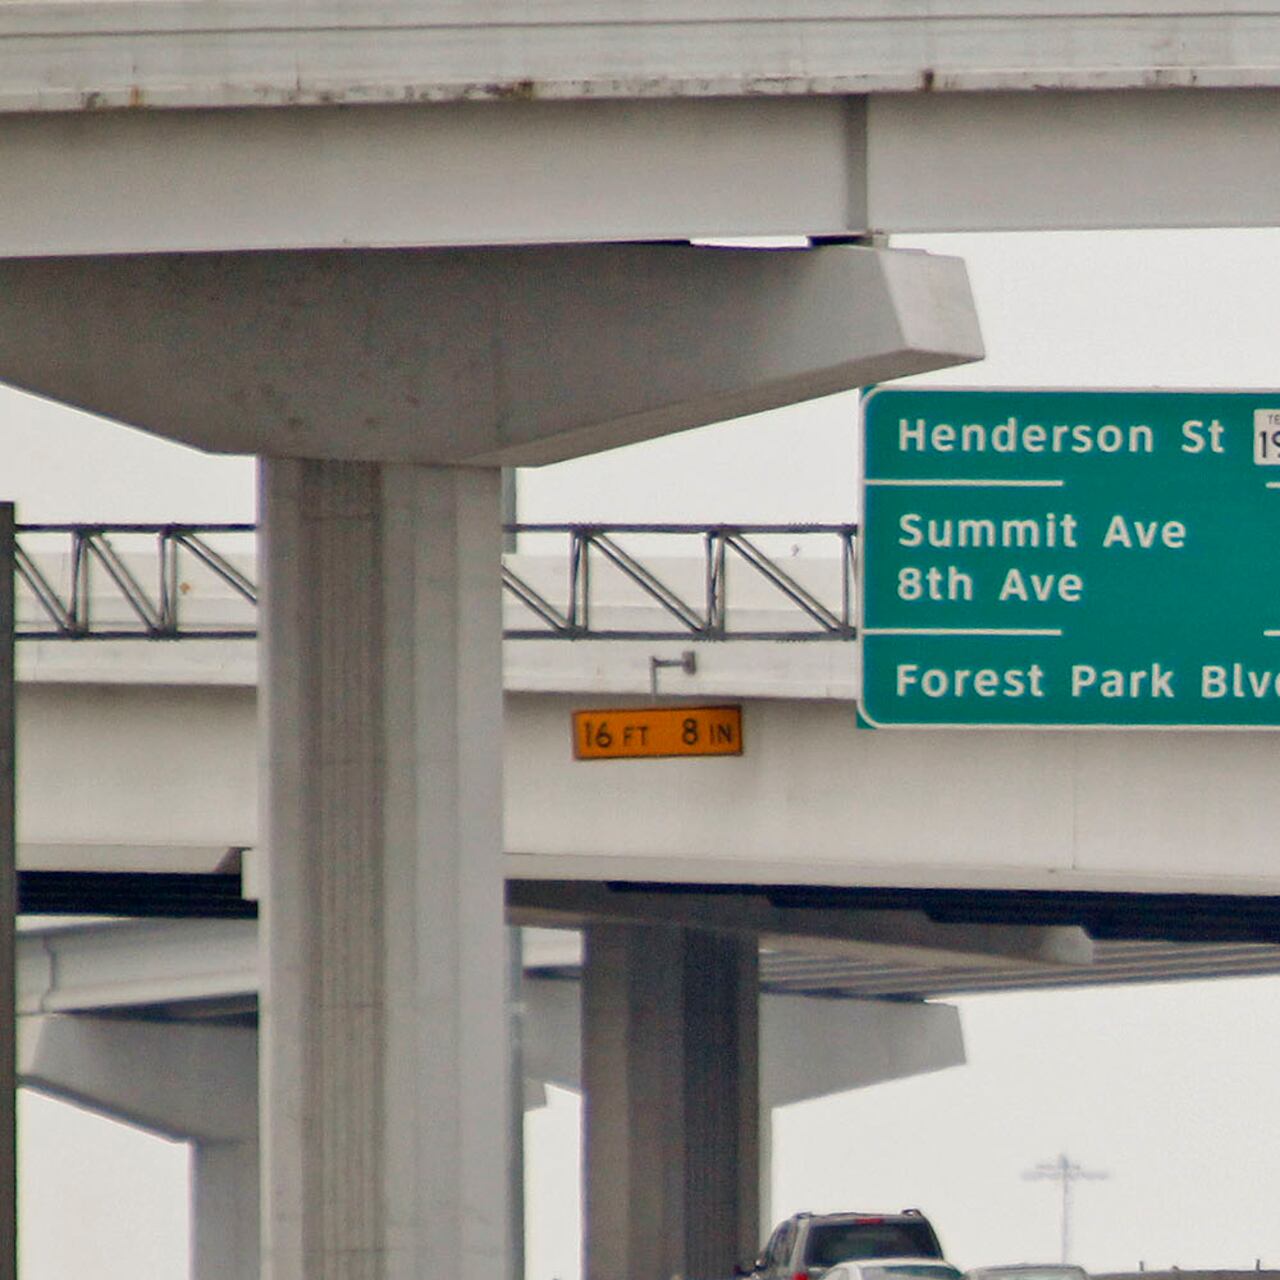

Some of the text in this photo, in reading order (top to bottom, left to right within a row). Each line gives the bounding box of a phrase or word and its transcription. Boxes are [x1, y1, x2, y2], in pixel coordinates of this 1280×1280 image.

[898, 417, 1154, 454] Henderson
[1181, 419, 1226, 454] St
[898, 513, 1187, 549] Summit Ave
[897, 566, 1084, 602] 8th Ave
[896, 663, 1045, 699] Forest
[1071, 663, 1175, 699] Park
[584, 718, 733, 748] 16 FT 8 IN
